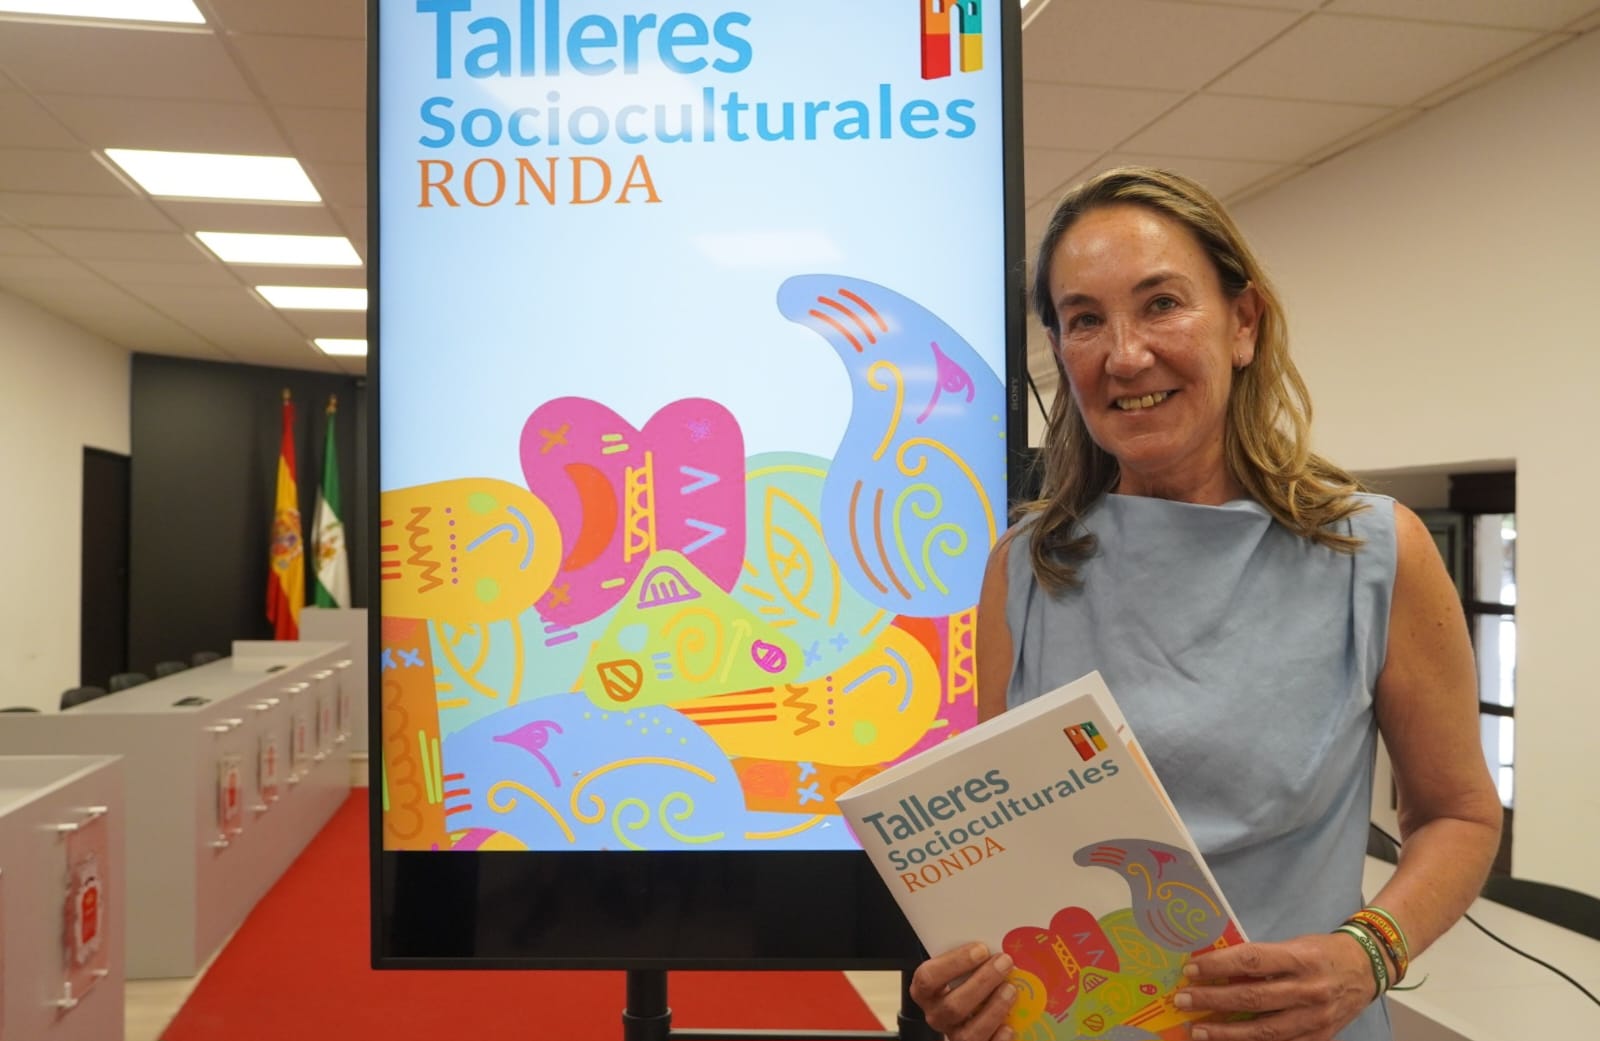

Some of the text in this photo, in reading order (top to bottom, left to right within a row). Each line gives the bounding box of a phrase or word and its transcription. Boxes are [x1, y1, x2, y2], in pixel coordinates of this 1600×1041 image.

[416, 0, 753, 79] Talleres
[418, 84, 976, 148] Socioculturales
[417, 154, 662, 208] RONDA
[862, 768, 1010, 846] Talleres
[888, 759, 1119, 871] Socioculturales
[900, 836, 1006, 893] RONDA
